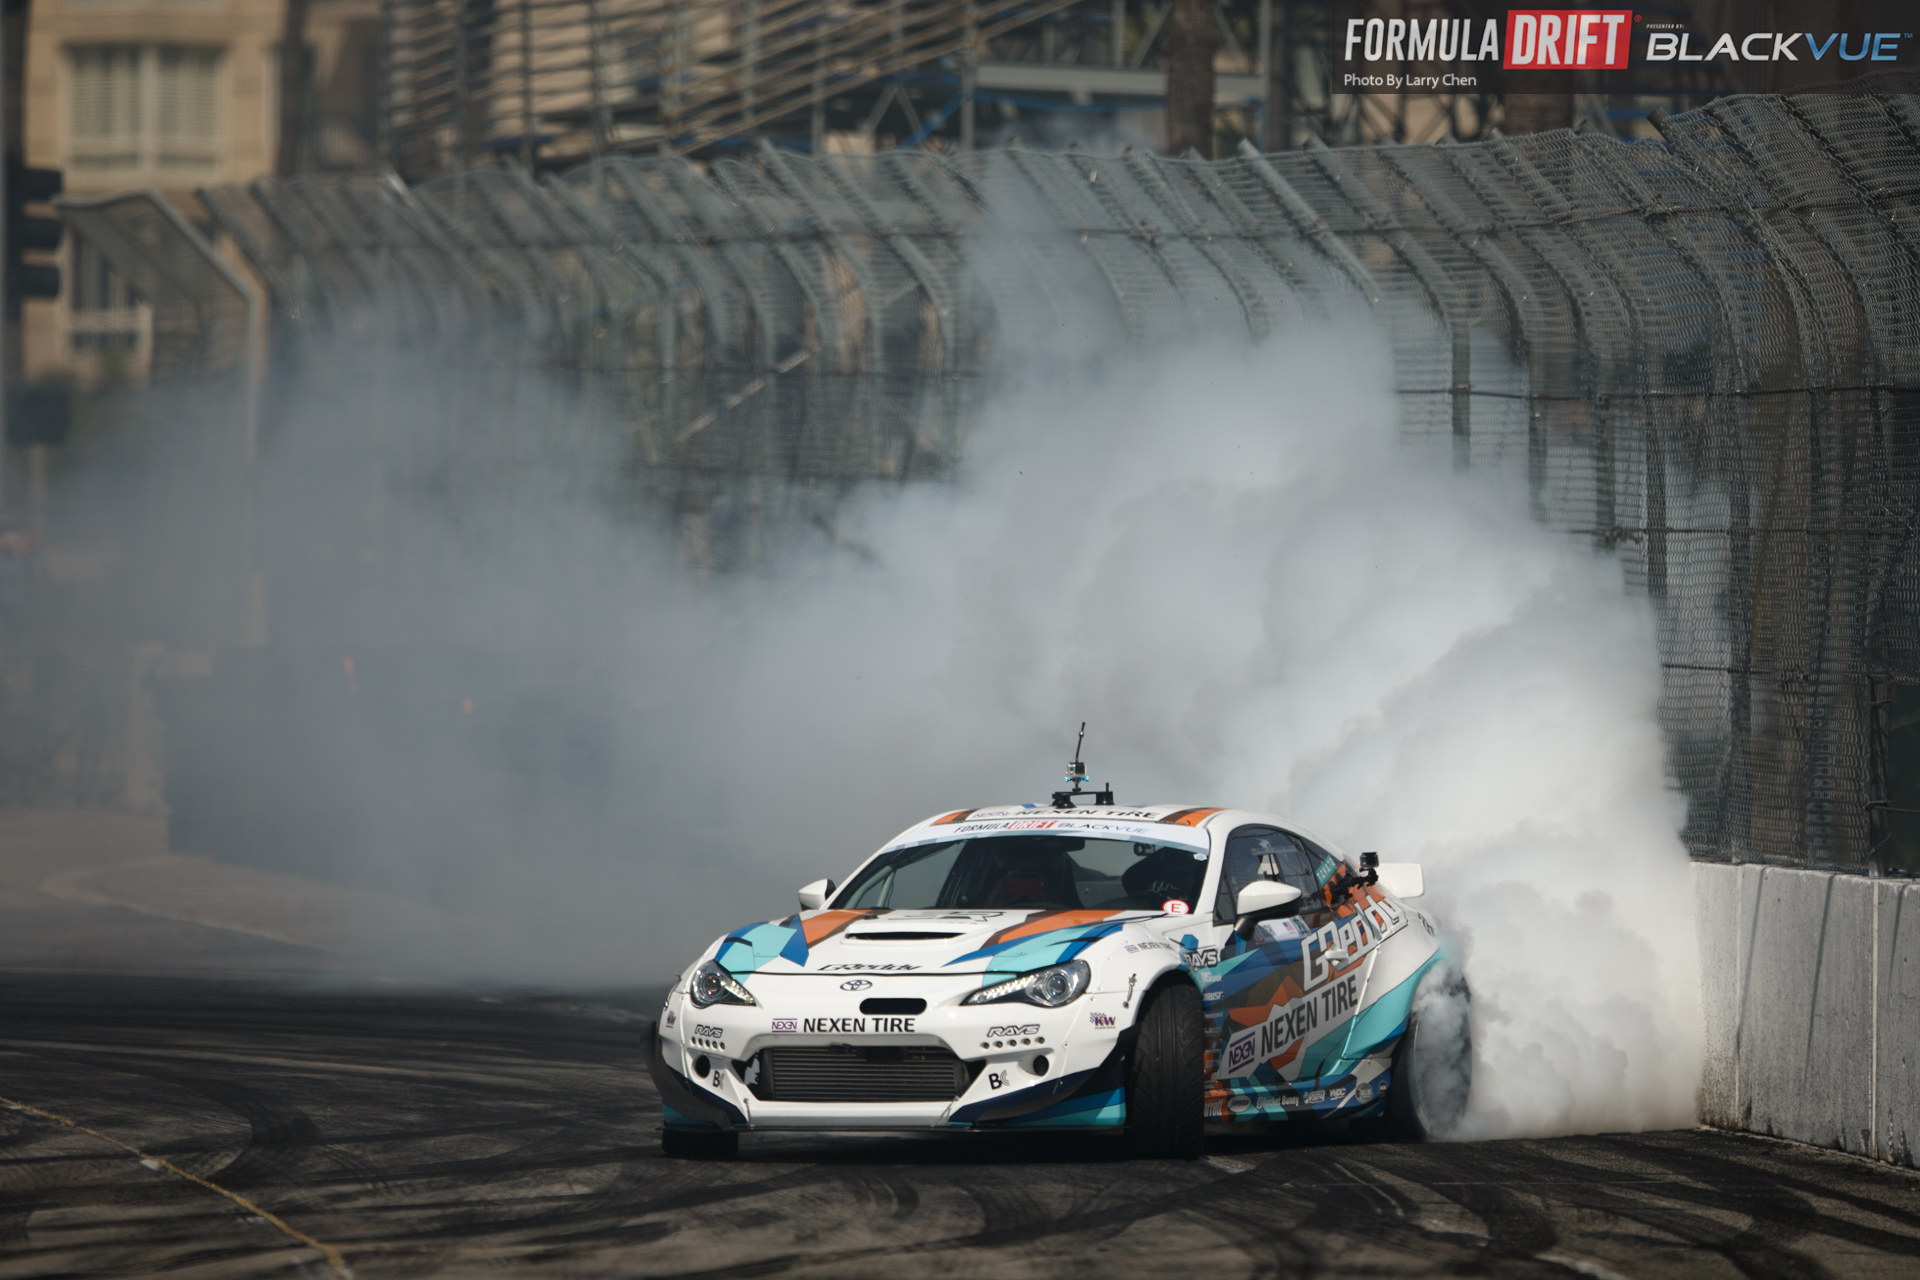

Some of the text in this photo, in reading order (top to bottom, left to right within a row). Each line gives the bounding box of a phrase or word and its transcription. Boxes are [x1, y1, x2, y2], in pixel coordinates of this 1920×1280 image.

[1017, 808, 1098, 816] NEXEN
[1106, 809, 1160, 820] TIRE
[954, 821, 1009, 833] FORMULA
[1058, 822, 1149, 834] BLACKVUE
[1171, 903, 1182, 914] E
[1261, 996, 1318, 1058] NEXEN
[1321, 973, 1359, 1022] TIRE
[694, 1024, 723, 1039] RAYS
[803, 1018, 866, 1033] NEXEN
[872, 1018, 915, 1033] TIRE
[987, 1023, 1041, 1038] RAYS
